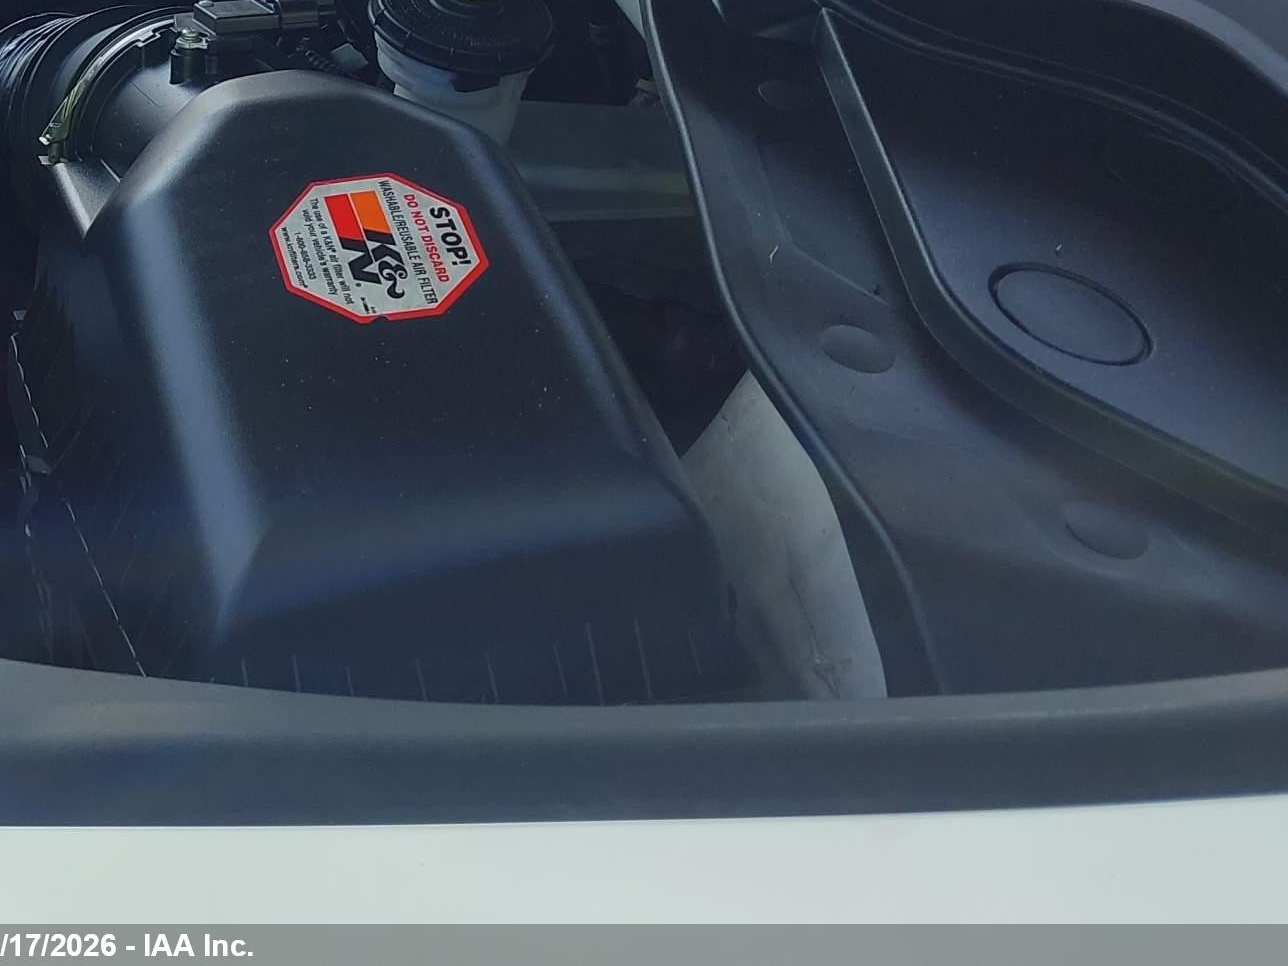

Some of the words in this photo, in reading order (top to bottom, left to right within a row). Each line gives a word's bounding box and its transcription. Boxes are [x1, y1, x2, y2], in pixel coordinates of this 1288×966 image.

[404, 194, 419, 208] DO
[302, 209, 312, 222] void
[314, 211, 323, 222] use
[378, 180, 420, 260] WASHABLE/REUSABLE
[411, 211, 430, 233] NOT
[304, 222, 317, 237] your
[318, 222, 328, 230] of
[430, 207, 471, 265] STOP!
[421, 235, 450, 283] DISCARD
[333, 264, 344, 279] filter
[412, 262, 427, 276] AIR
[339, 279, 351, 292] will
[418, 277, 439, 305] FILTER
[343, 292, 355, 305] not
